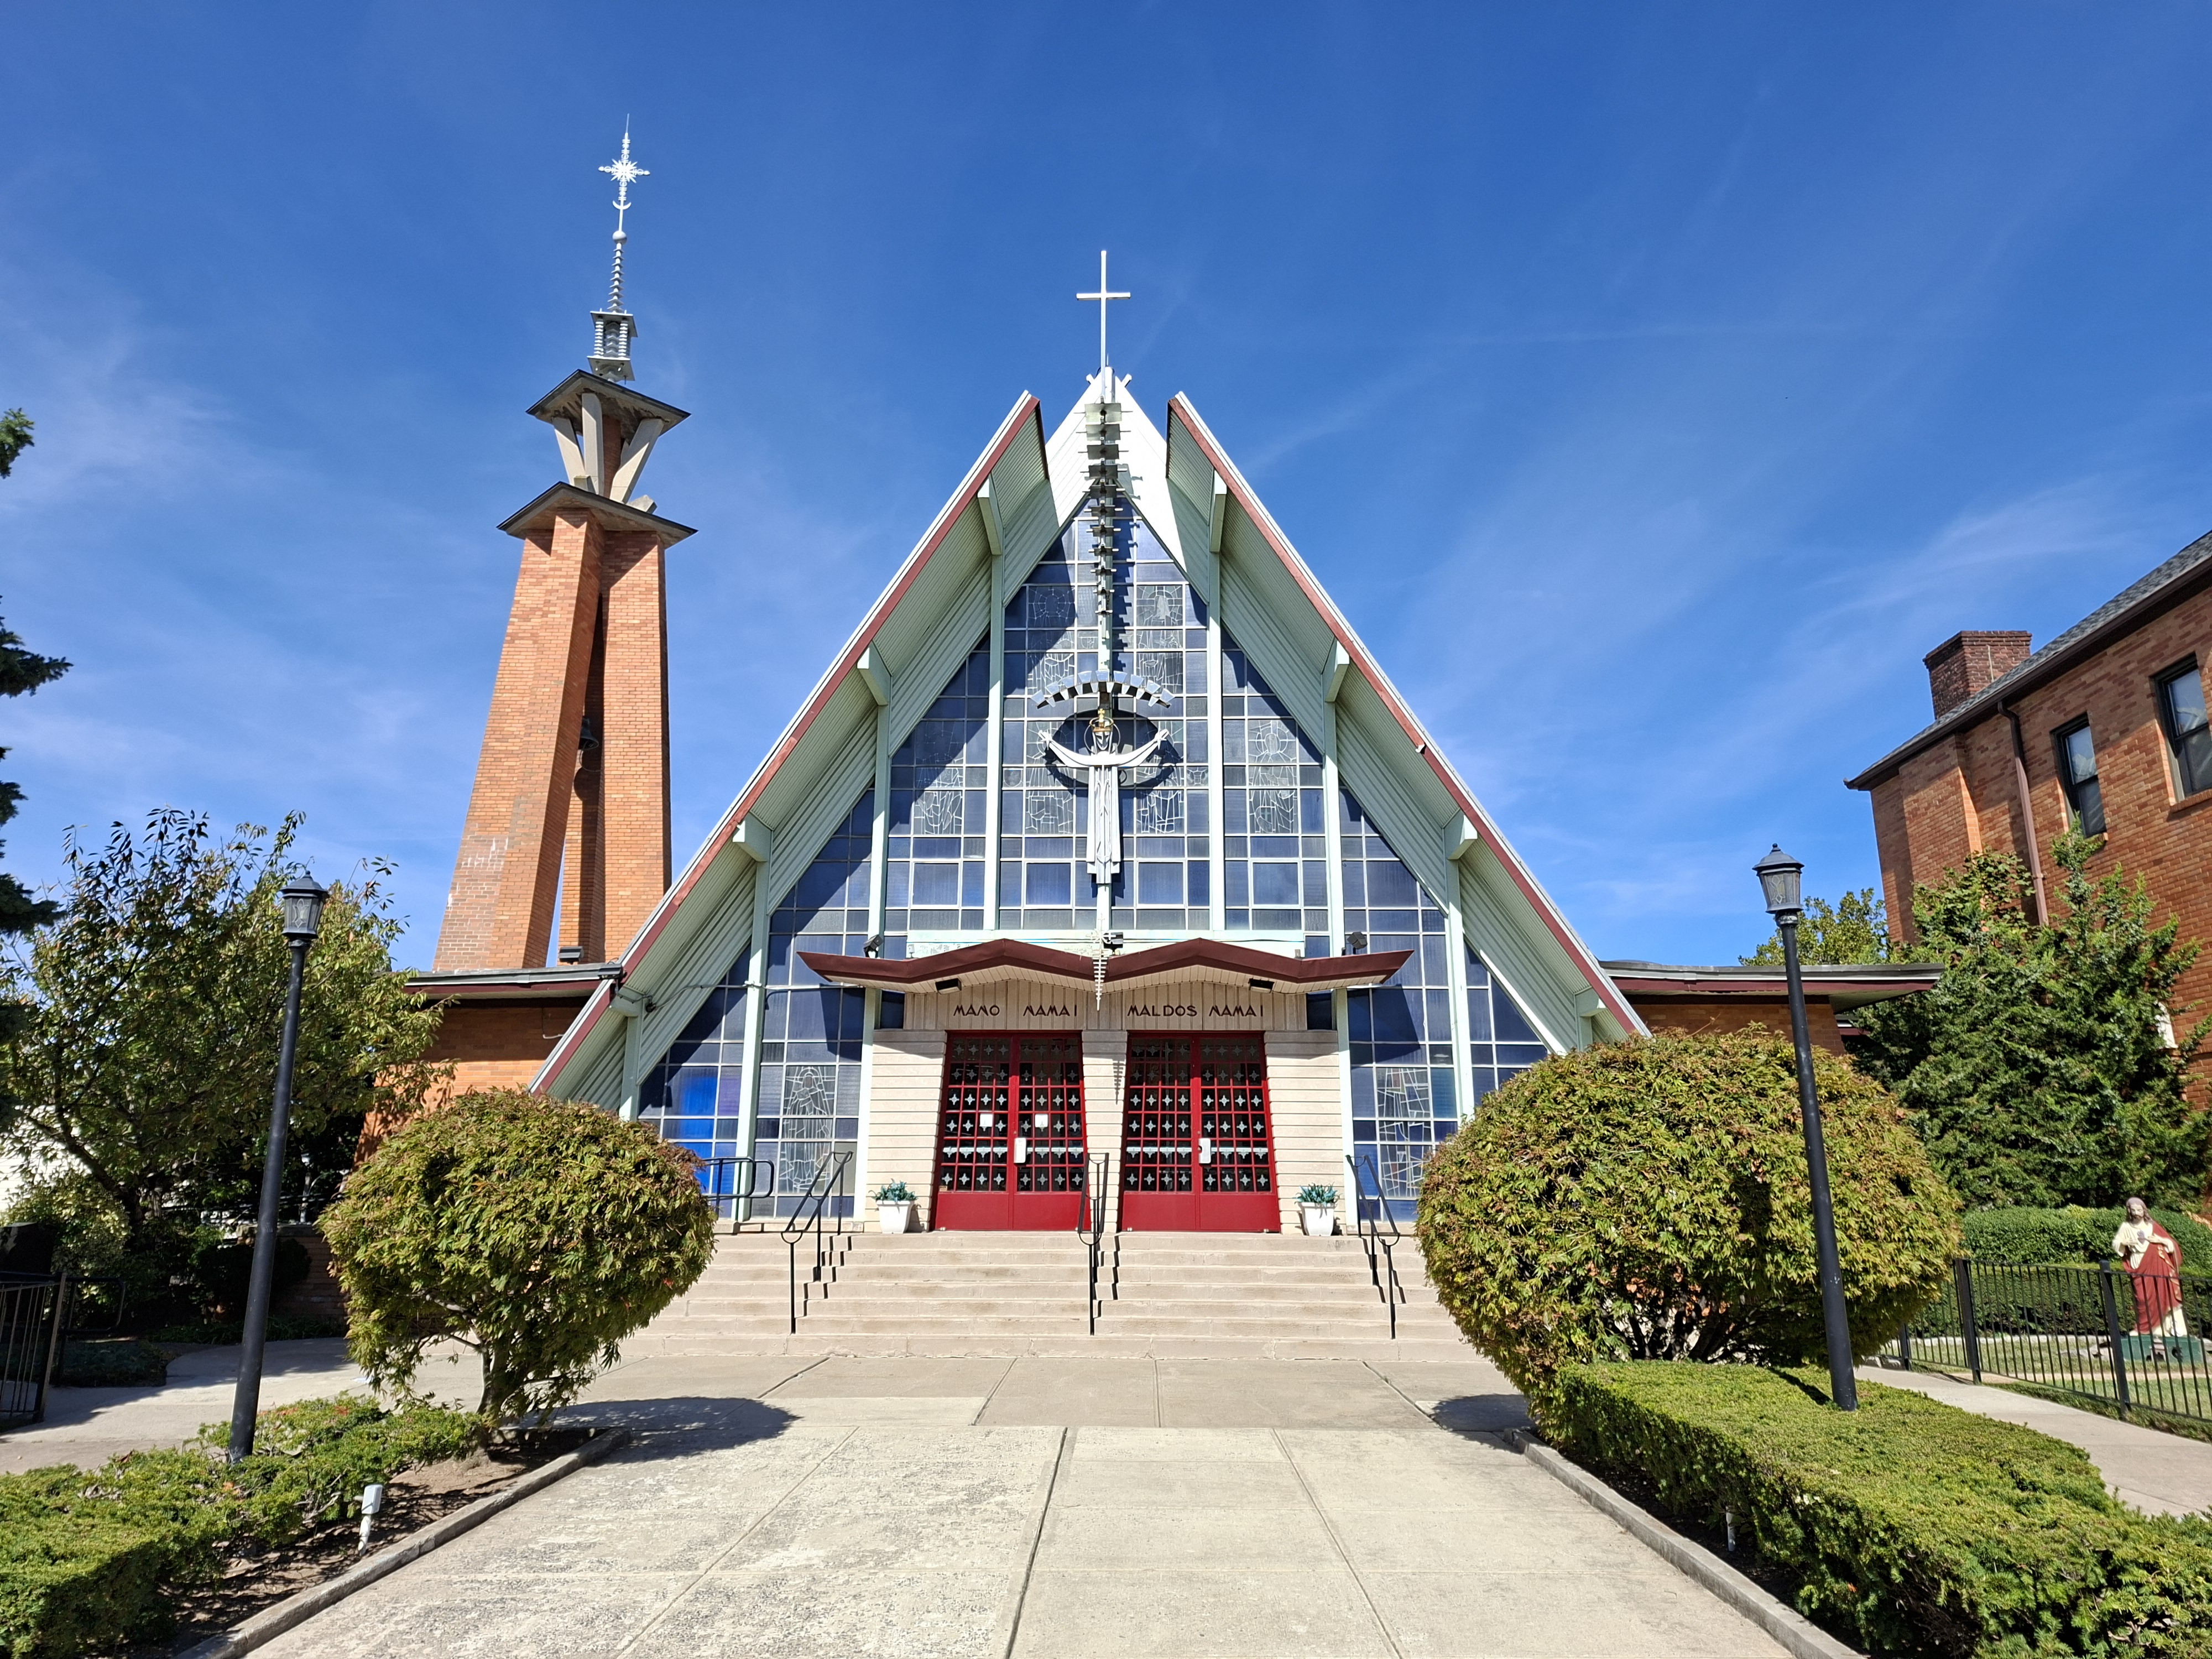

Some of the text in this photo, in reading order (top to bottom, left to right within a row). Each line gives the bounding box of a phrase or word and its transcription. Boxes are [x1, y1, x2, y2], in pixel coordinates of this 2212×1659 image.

[953, 1004, 1263, 1017] MANO NAMAI MALDOS NAMAI
